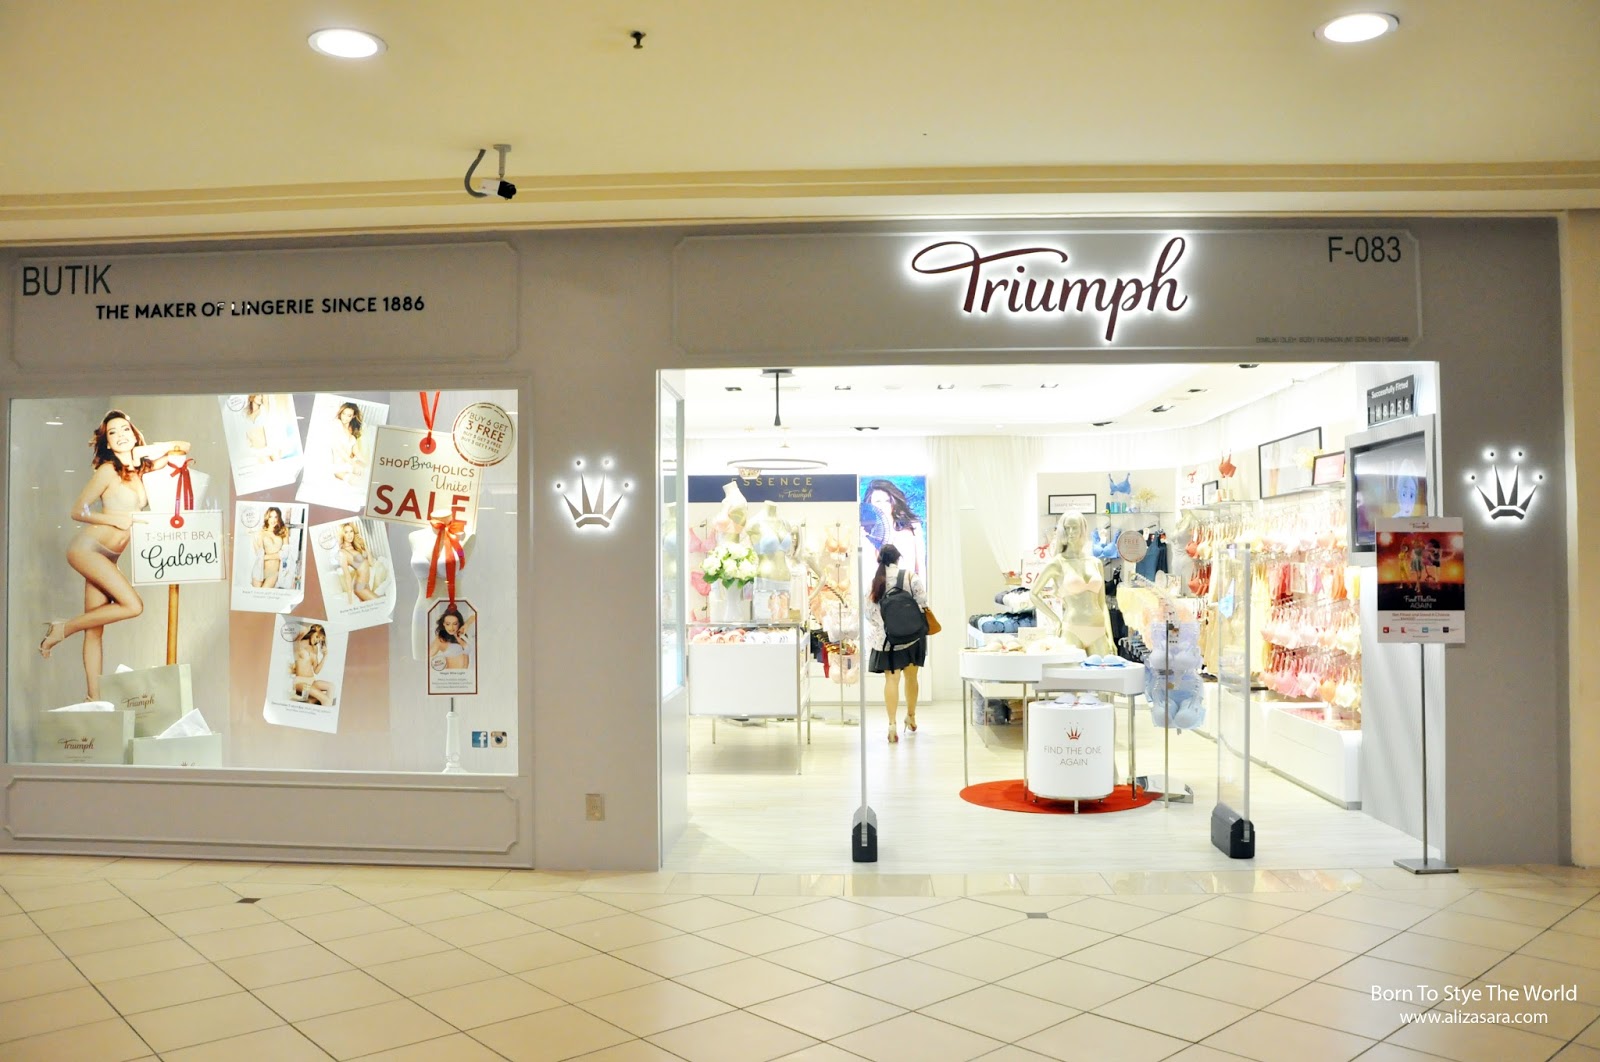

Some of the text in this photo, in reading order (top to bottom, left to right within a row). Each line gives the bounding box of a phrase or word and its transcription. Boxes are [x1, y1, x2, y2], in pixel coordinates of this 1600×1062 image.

[1328, 236, 1401, 263] F-083
[23, 265, 112, 296] BUTIK
[911, 237, 1188, 341] Triumph
[96, 296, 425, 320] THE MAKER OF LINGERIE SINCE 1886
[1371, 380, 1409, 399] Successfully Fitted
[466, 420, 505, 443] 3 FREE
[469, 412, 486, 424] BUY
[493, 421, 509, 432] GET
[431, 475, 472, 493] Unite!
[784, 488, 813, 501] Triumph
[145, 531, 214, 541] T-SHIRT BRA
[141, 542, 218, 579] Galore!
[122, 694, 155, 709] Triumph
[58, 737, 95, 752] Triumph
[1044, 746, 1102, 755] FIND THE ONE
[1059, 758, 1088, 766] AGAIN
